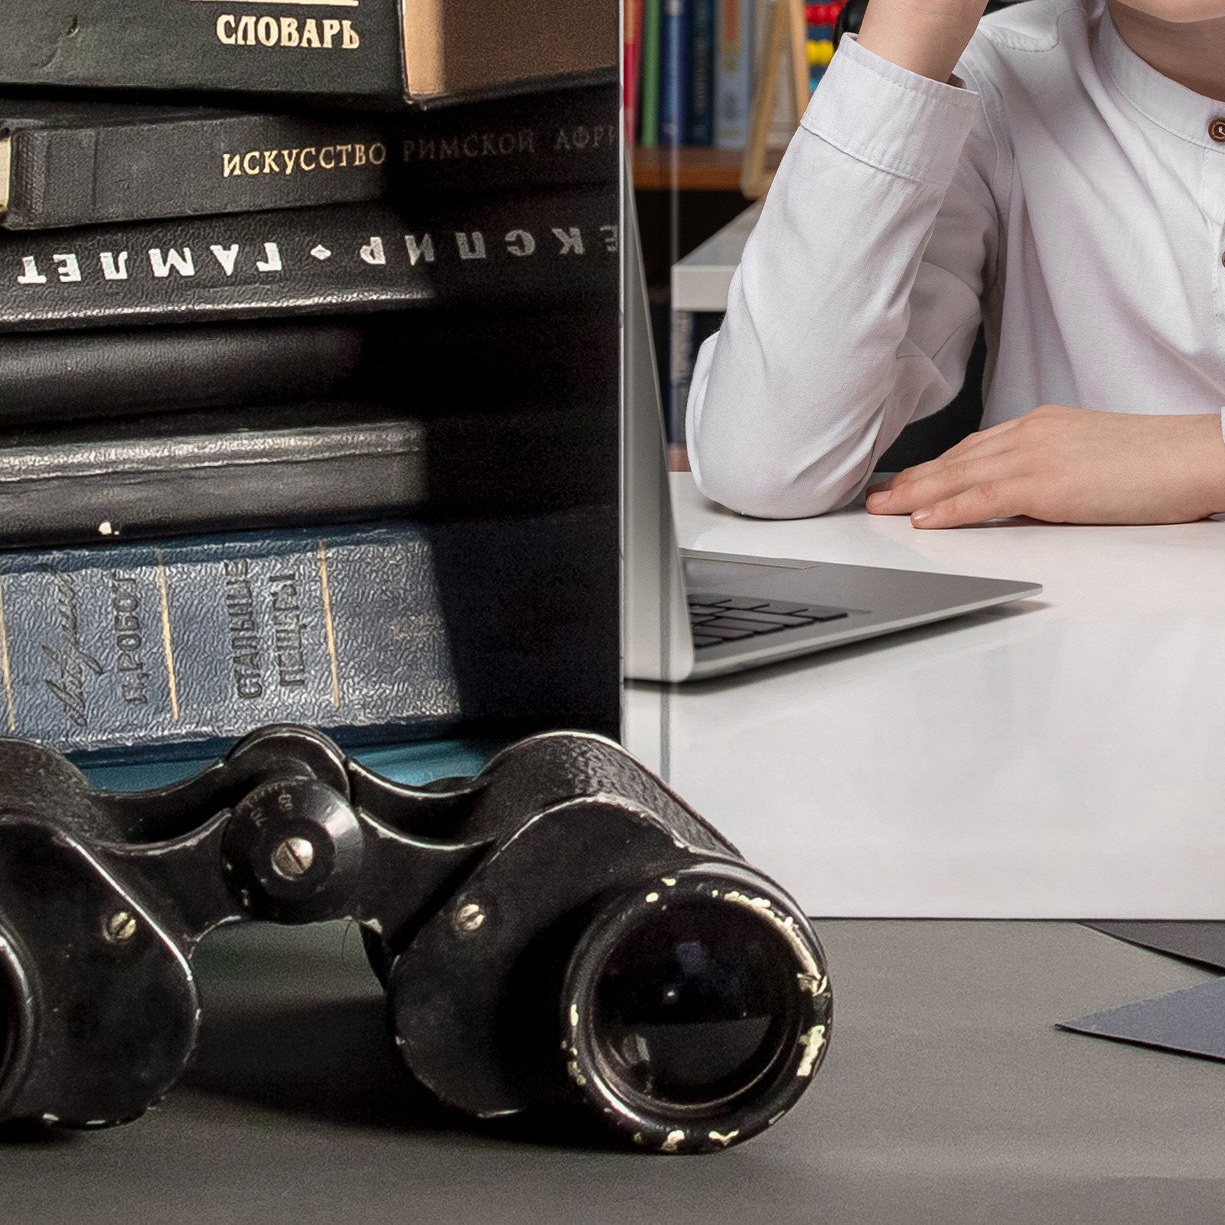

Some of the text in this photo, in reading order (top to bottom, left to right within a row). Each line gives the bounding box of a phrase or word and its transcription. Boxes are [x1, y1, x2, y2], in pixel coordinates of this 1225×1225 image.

[216, 14, 360, 49] СЛОВАРЬ
[222, 142, 386, 177] ИСКУССТВО
[402, 128, 536, 162] РИМСКОЙ
[17, 242, 283, 284] ГАМЛЕТ
[223, 558, 263, 700] СТАЛЬНЫЕ
[269, 573, 307, 687] ПЕЩЕРЫ
